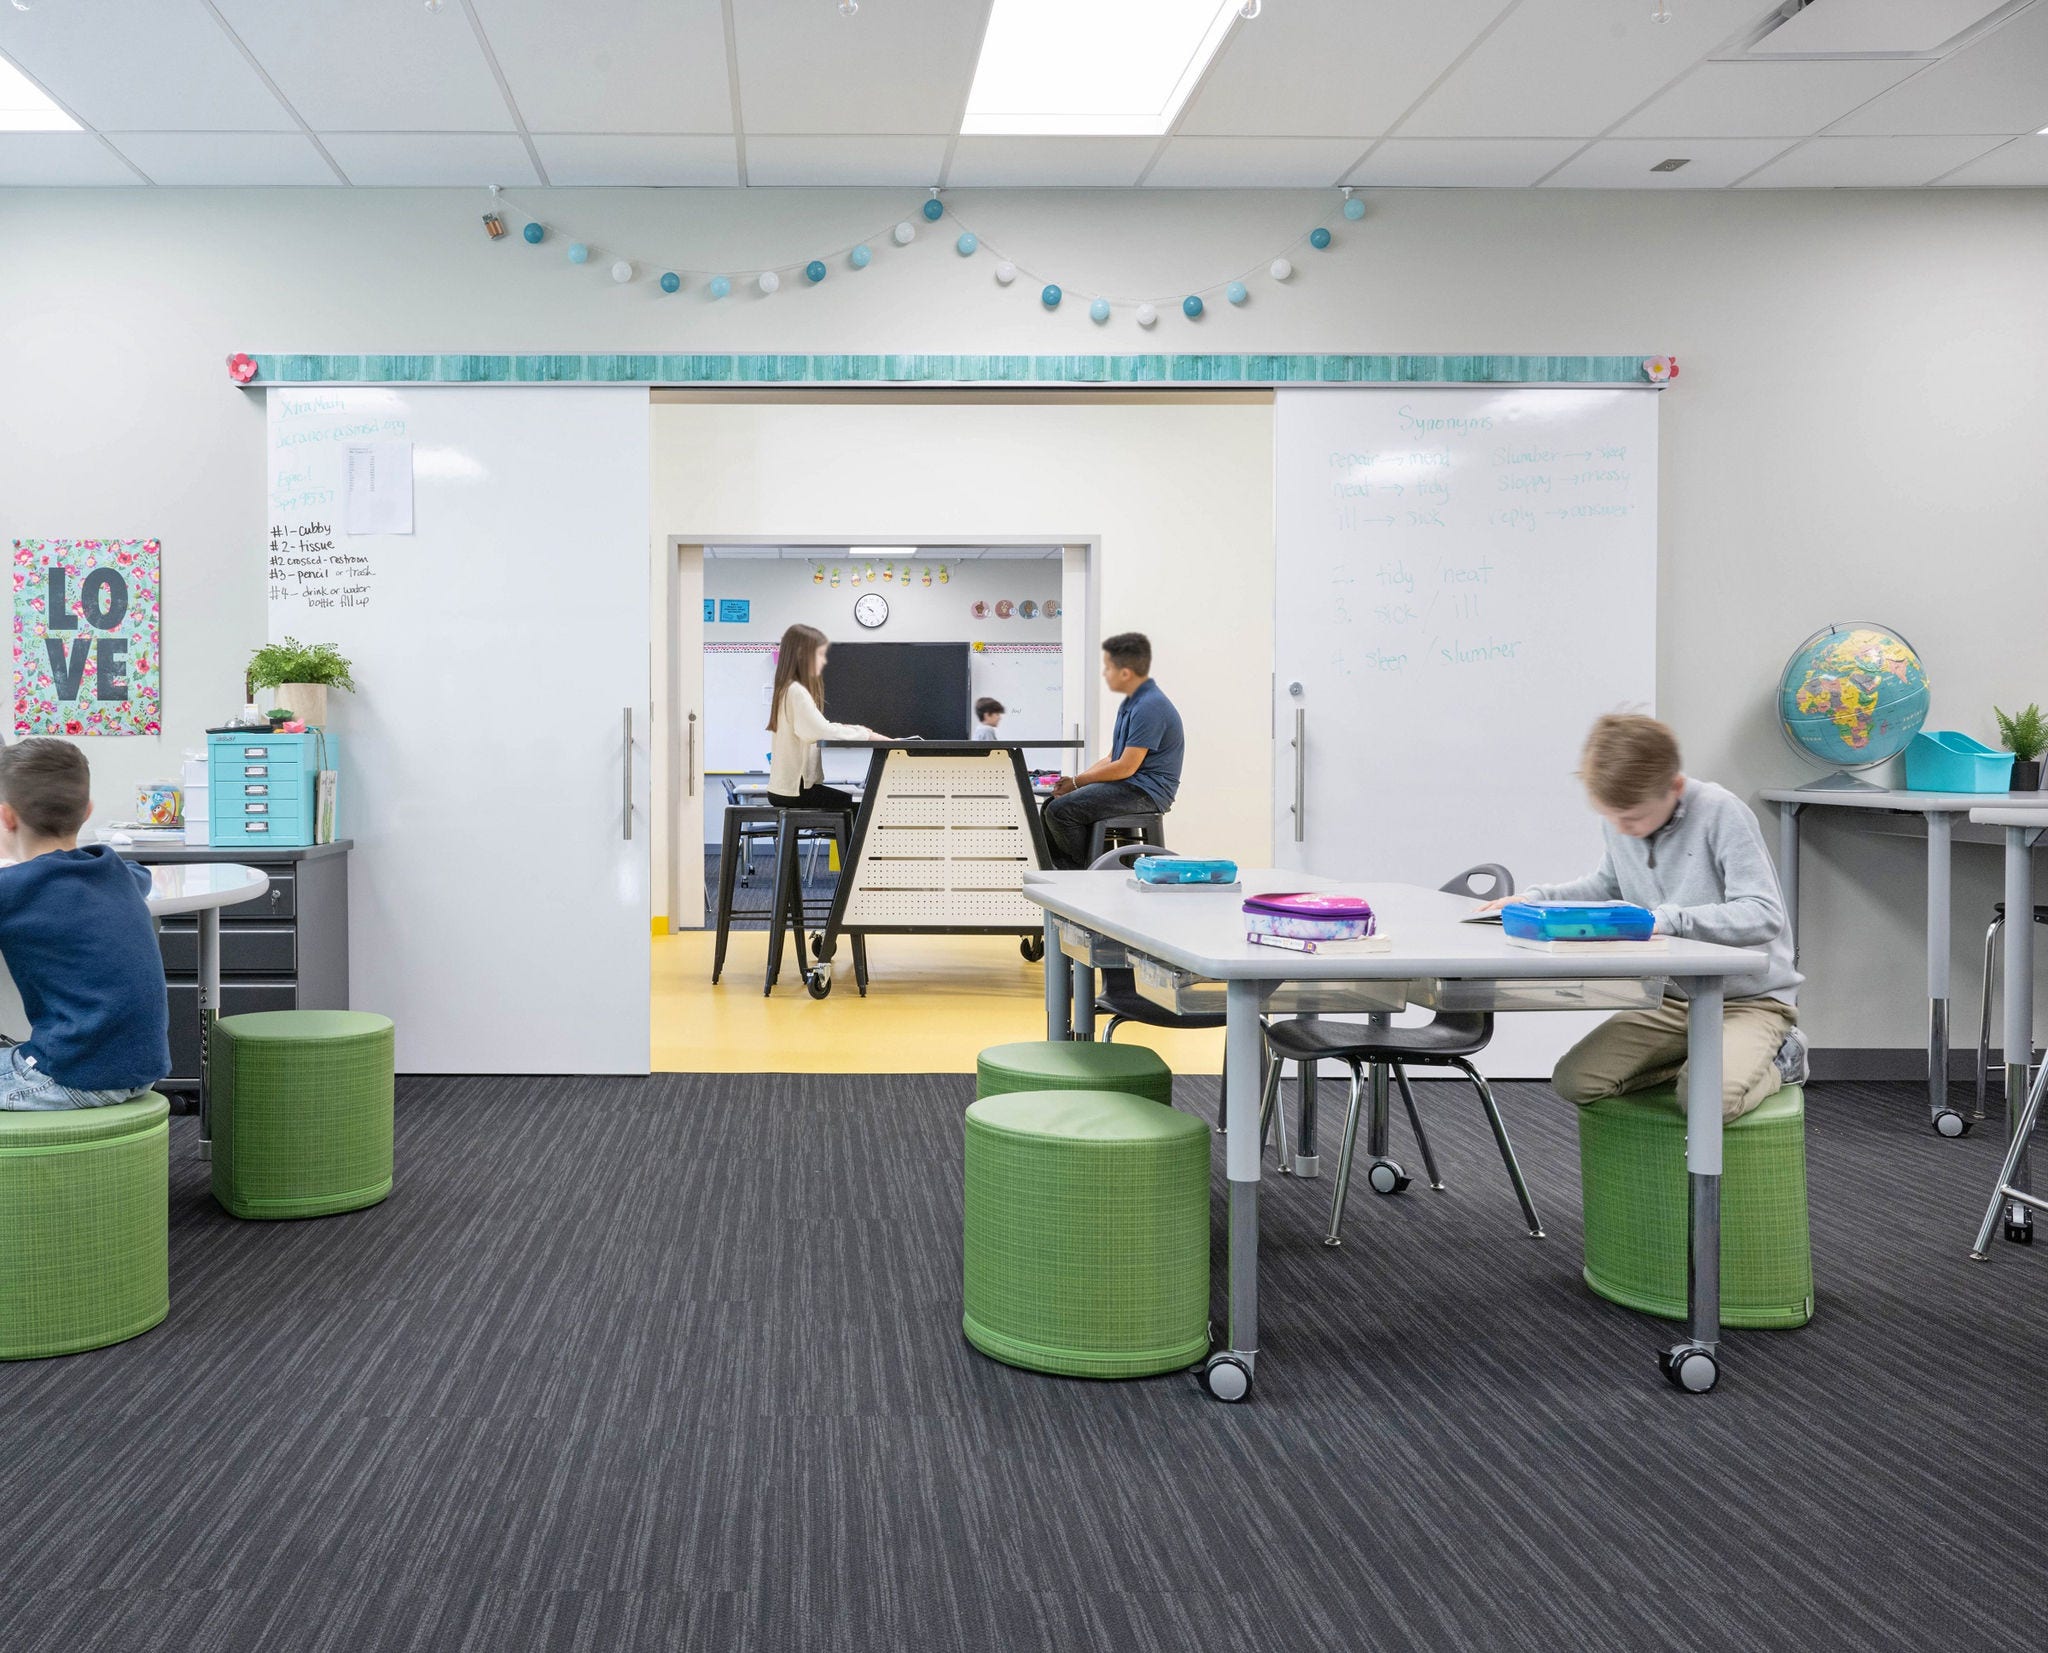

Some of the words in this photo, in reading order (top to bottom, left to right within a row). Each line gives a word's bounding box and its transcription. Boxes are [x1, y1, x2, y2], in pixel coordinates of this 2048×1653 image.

[1398, 405, 1493, 440] Synonyms
[1328, 450, 1380, 476] repair
[1409, 445, 1450, 467] mend
[1333, 476, 1373, 498] neat
[1375, 560, 1414, 593] tidy
[1443, 555, 1494, 584] neat
[302, 585, 328, 598] drink
[329, 587, 340, 595] or
[1374, 602, 1419, 625] sick
[1451, 593, 1479, 619] ill
[1441, 636, 1521, 665] slumber
